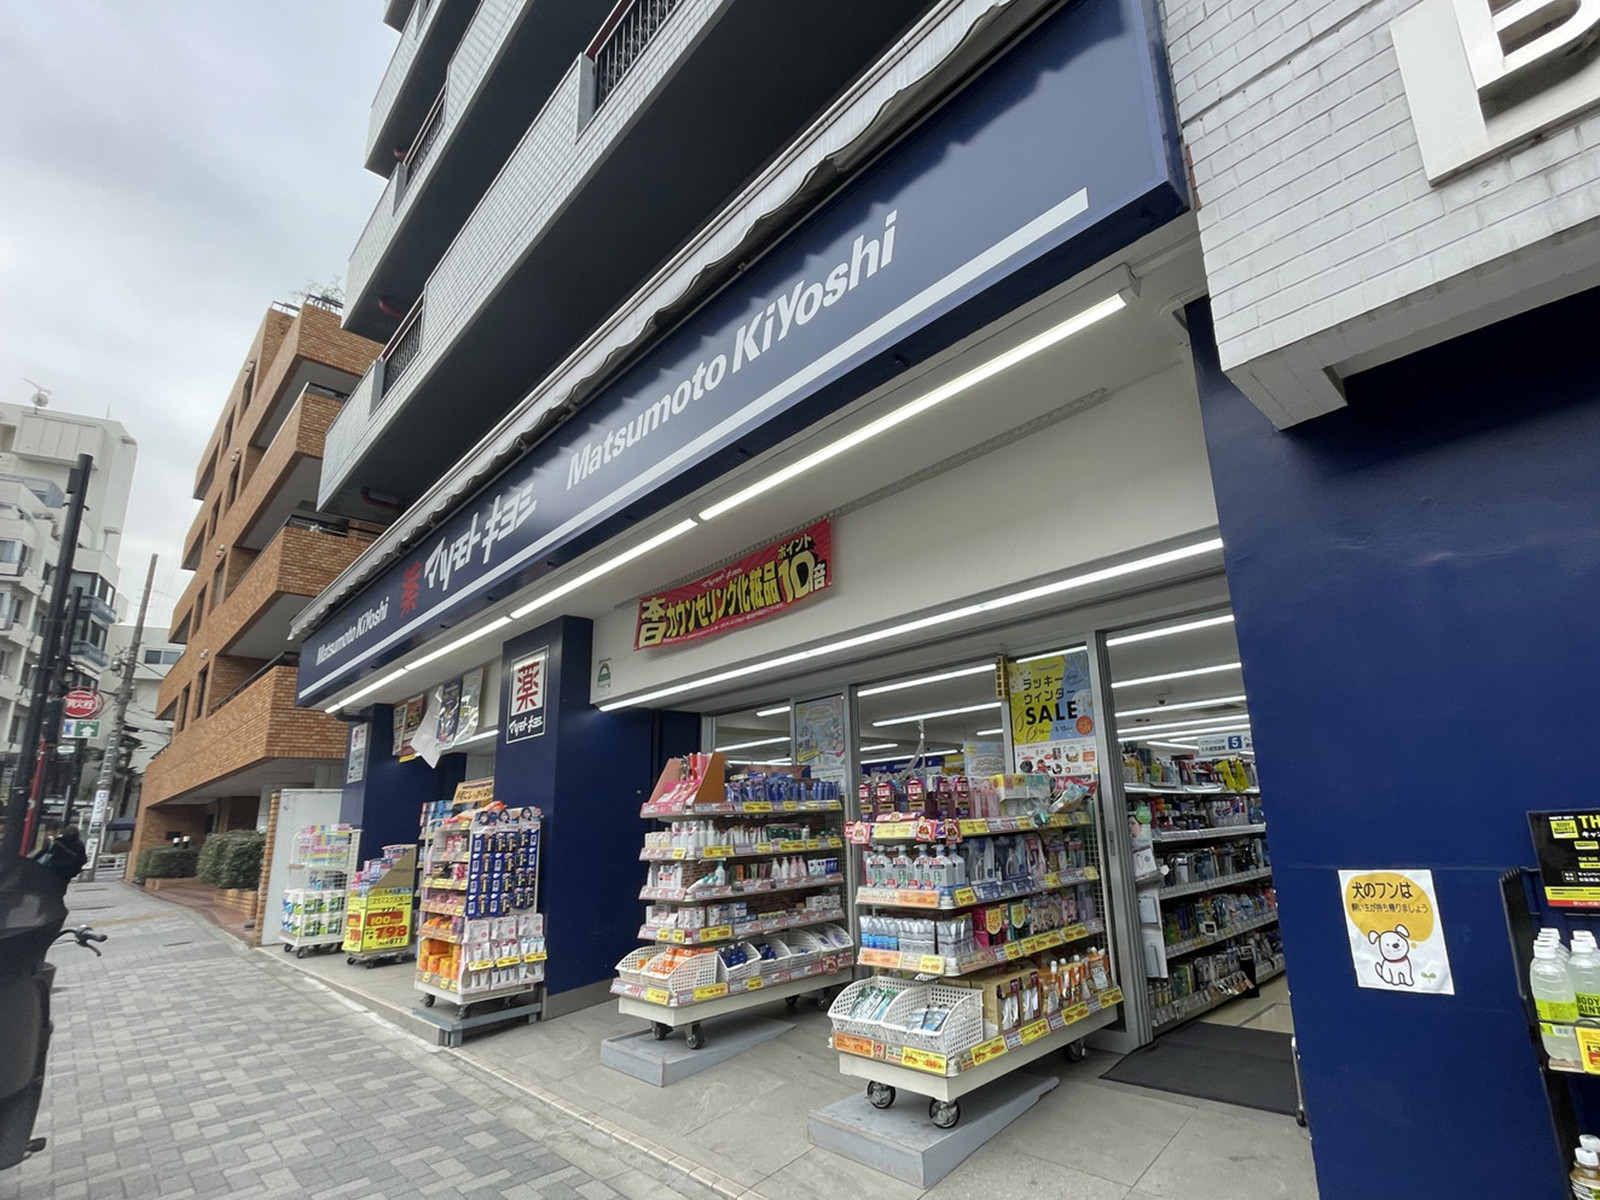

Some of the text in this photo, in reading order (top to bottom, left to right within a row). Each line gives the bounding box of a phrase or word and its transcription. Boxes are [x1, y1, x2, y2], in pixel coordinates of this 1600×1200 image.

[566, 209, 898, 491] Matsumoto KiYoshi
[777, 533, 813, 559] ポイント
[638, 596, 667, 648] 本日
[516, 661, 540, 713] 薬
[1023, 675, 1064, 691] ラッキー
[1025, 700, 1079, 726] SALE
[1231, 737, 1239, 748] 5
[1352, 882, 1413, 899] 犬のフンは
[375, 924, 408, 940] 798
